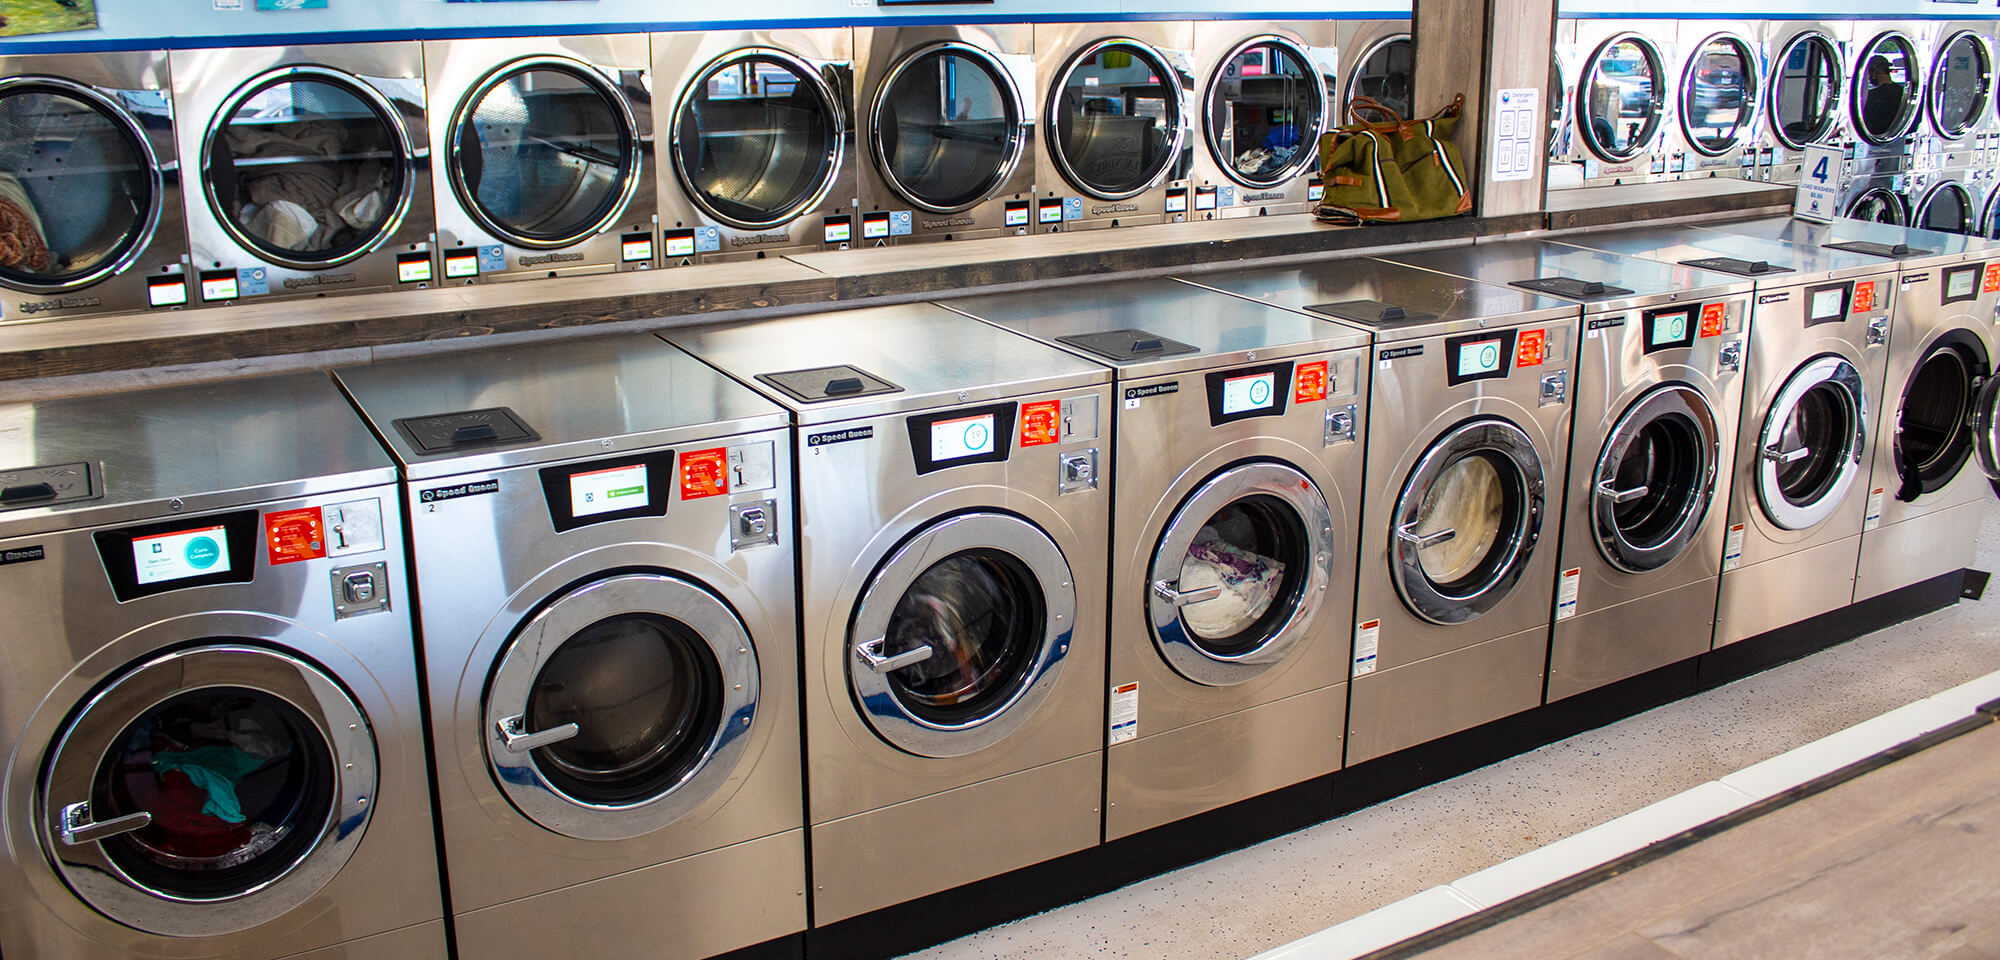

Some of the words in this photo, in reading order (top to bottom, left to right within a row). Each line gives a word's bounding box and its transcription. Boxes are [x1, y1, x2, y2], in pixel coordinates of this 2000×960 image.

[1812, 156, 1829, 184] 4
[1137, 387, 1158, 396] Speed
[1158, 384, 1178, 392] Queen
[822, 432, 847, 442] Speed
[848, 429, 873, 438] Queen
[814, 447, 820, 456] 3
[436, 486, 466, 498] Speed
[468, 482, 498, 493] Queen
[428, 503, 435, 513] 2
